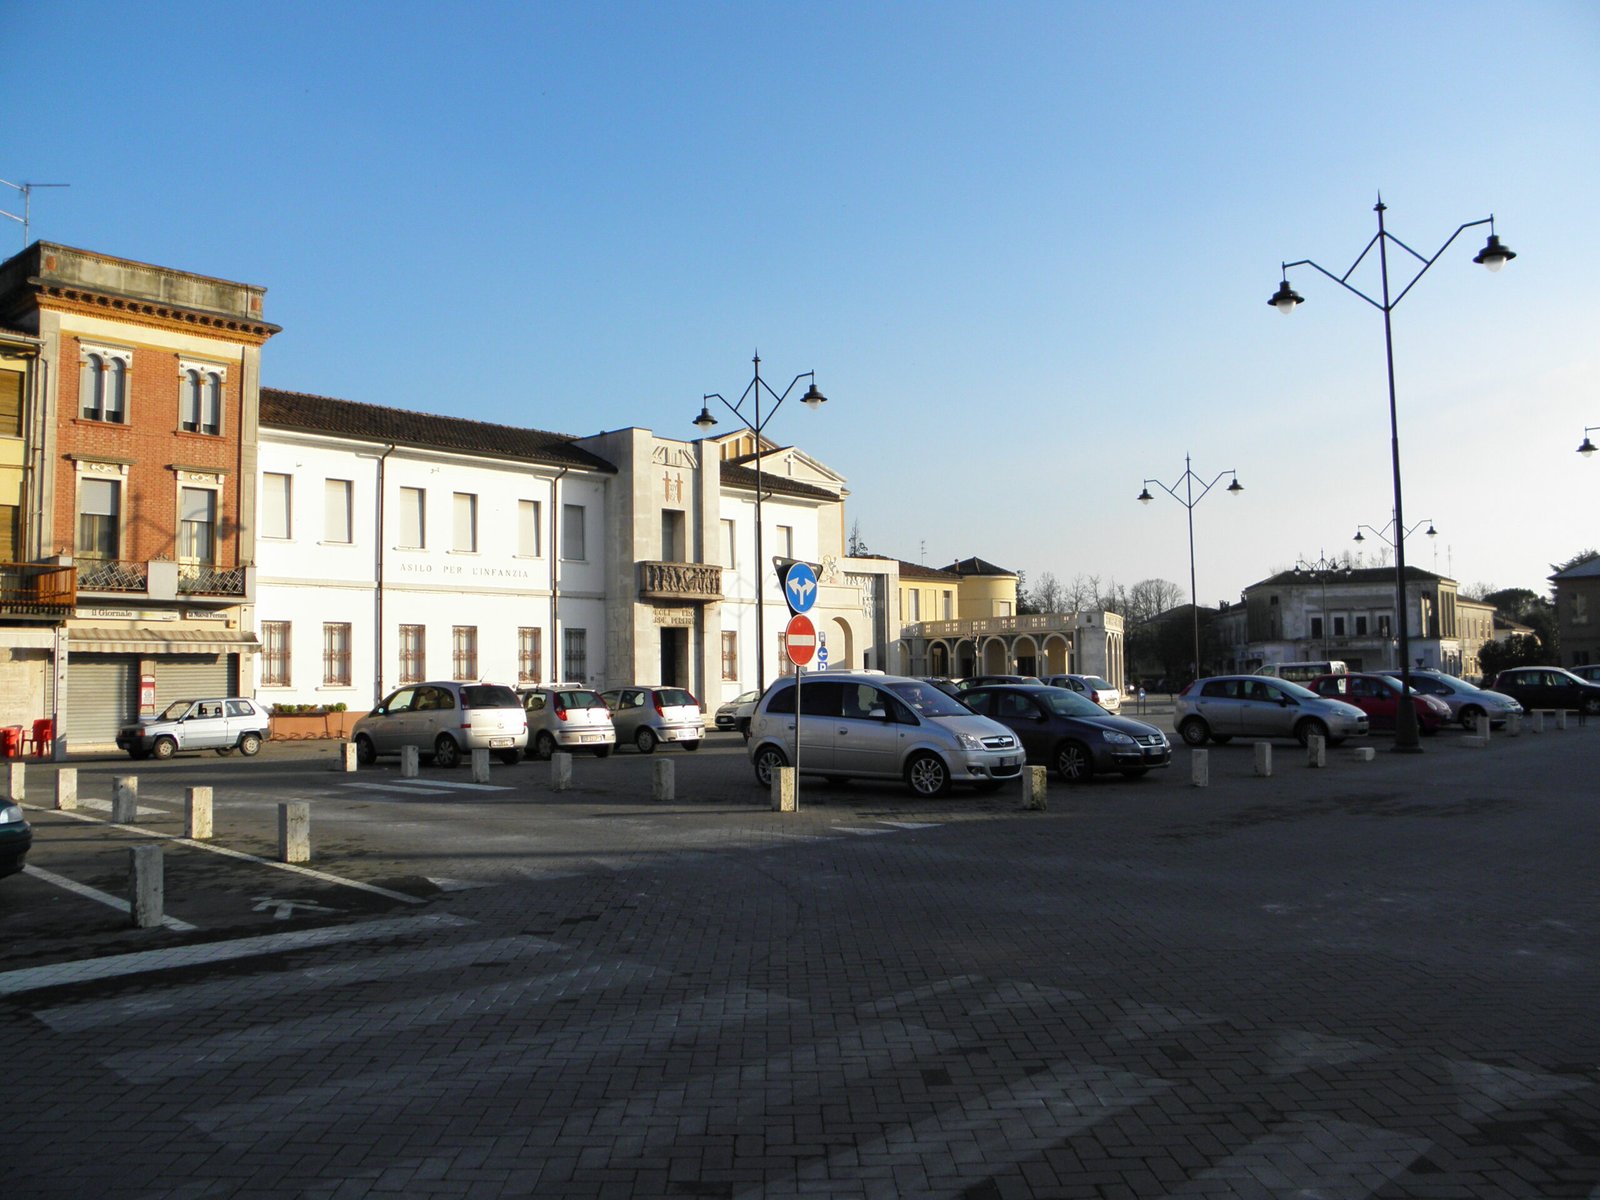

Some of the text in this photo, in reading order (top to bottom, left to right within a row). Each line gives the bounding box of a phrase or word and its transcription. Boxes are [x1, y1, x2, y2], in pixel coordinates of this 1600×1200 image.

[400, 563, 528, 578] ASILO PER L'INFANZIA
[98, 608, 133, 617] Giornale
